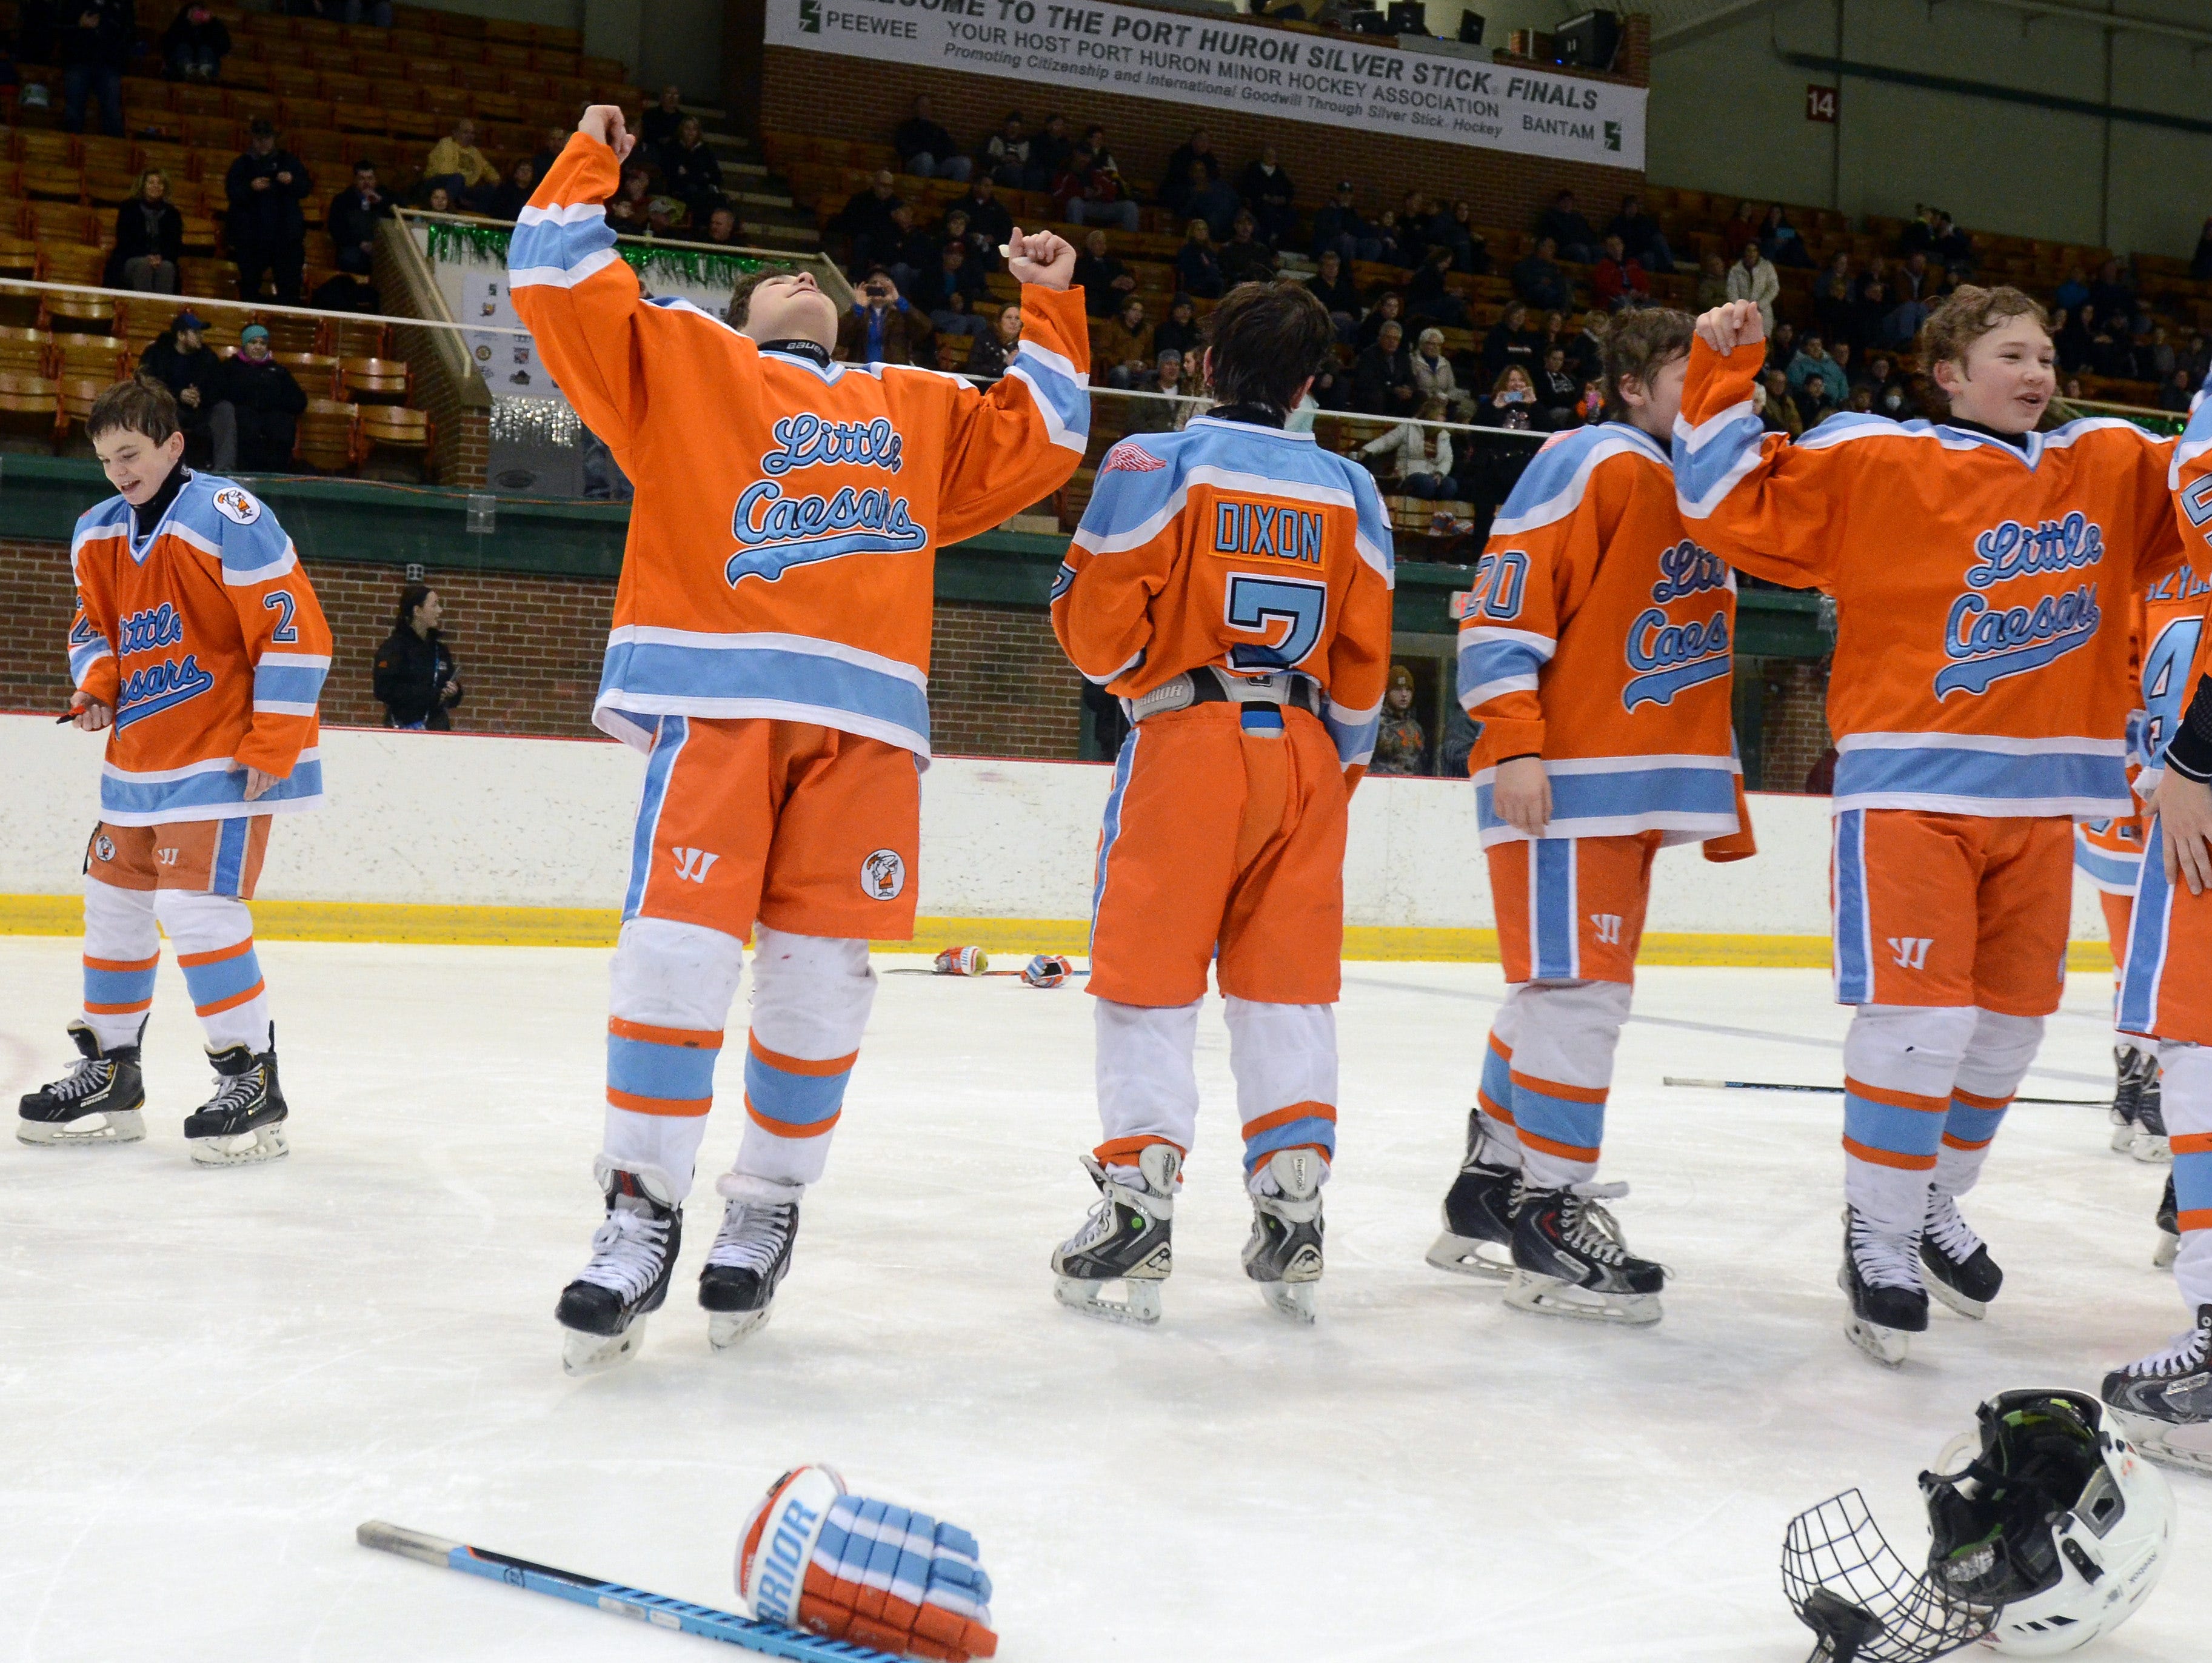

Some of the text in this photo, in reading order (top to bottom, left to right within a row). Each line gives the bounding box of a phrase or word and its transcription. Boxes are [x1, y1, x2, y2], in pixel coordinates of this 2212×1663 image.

[826, 10, 918, 39] PEEWEE
[1000, 0, 1035, 24] TO
[1048, 4, 1104, 35] THE
[1111, 15, 1192, 48] PORT
[1199, 28, 1300, 64] HURON
[1307, 45, 1404, 81] SILVER
[1412, 61, 1492, 95] STICK
[1507, 76, 1598, 110] FINALS
[944, 41, 1502, 139] Promoting Citizenship and International Goodwill Through Silver Stick Hockey
[947, 20, 1499, 118] YOUR HOST PORT HURON MINOR HOCKEY ASSOCIATION
[1523, 113, 1595, 140] BANTAM
[1809, 90, 1834, 118] 14
[760, 412, 903, 477] Little
[732, 479, 914, 544] Caesars
[1214, 501, 1323, 564] DIXON
[1964, 509, 2105, 589] Little
[262, 589, 298, 644] 2
[1461, 549, 1532, 621] 20
[1225, 572, 1327, 672] 7
[1944, 583, 2100, 659] Caesars
[1297, 1159, 1305, 1191] Reebok
